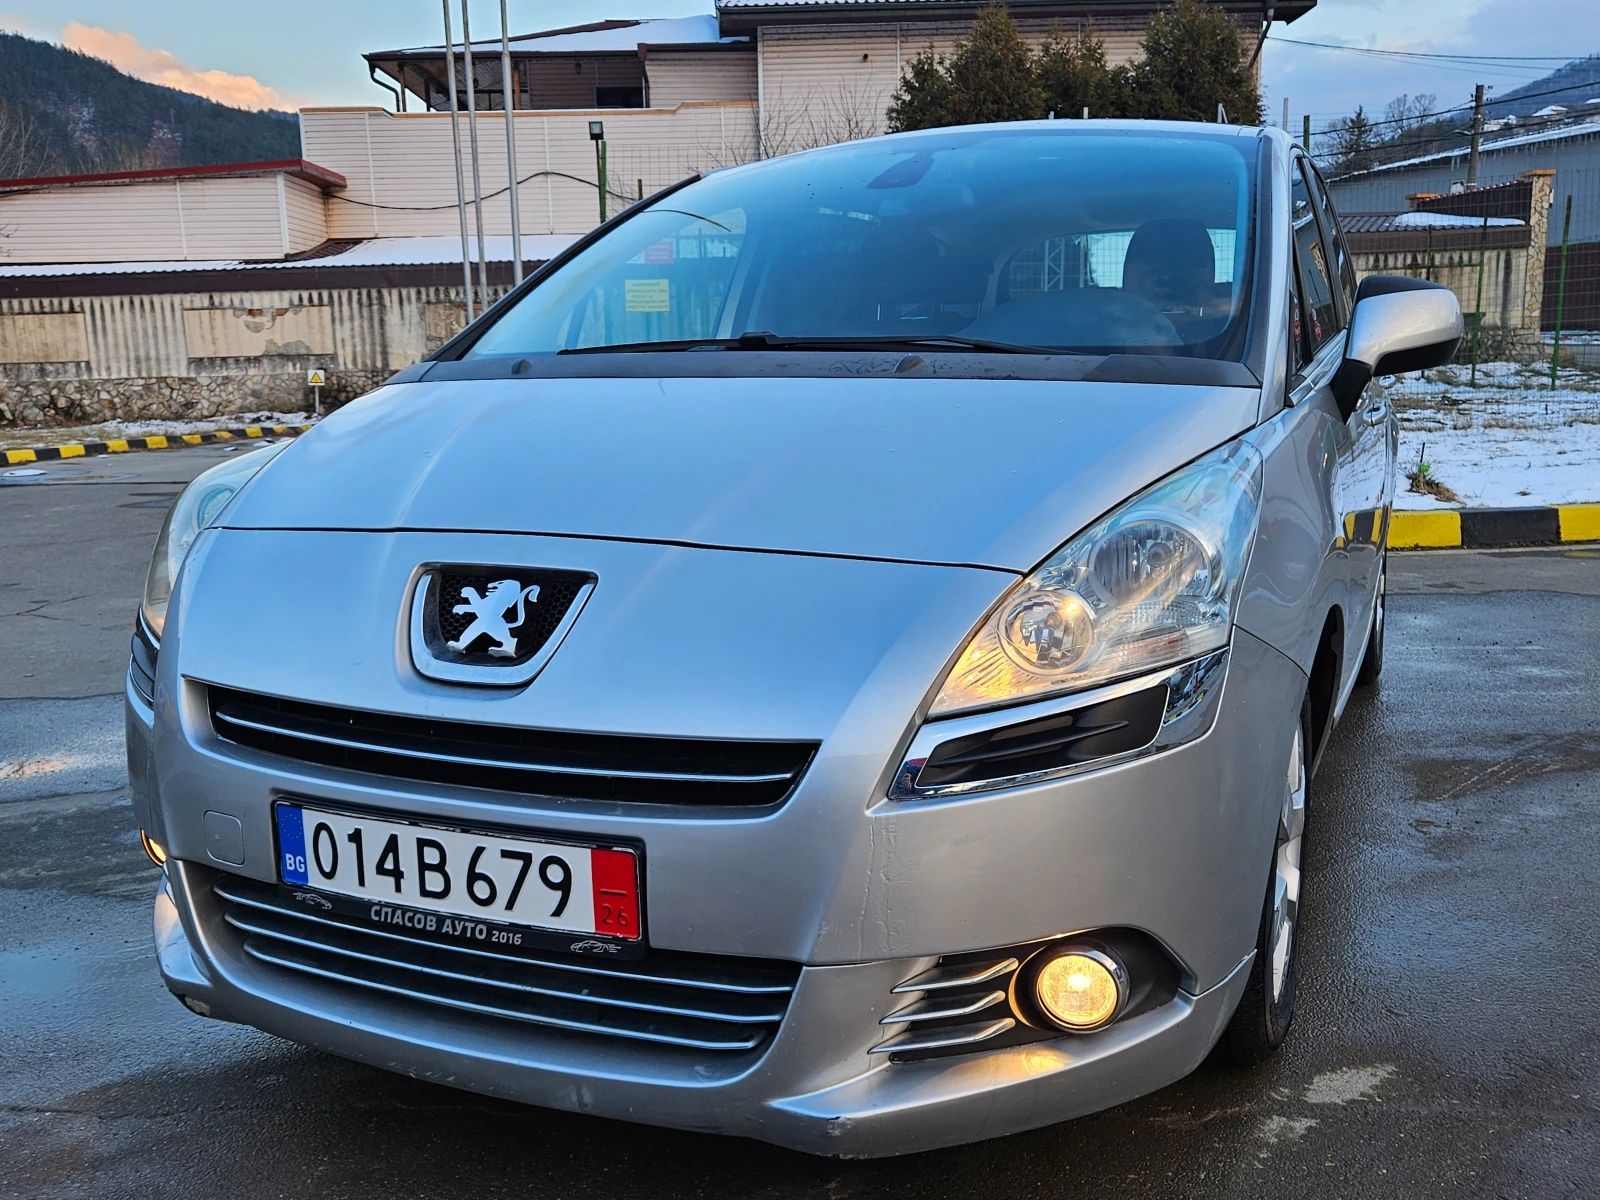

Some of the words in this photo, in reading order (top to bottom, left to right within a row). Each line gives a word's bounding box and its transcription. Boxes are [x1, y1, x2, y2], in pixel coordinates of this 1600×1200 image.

[285, 853, 305, 872] BG
[370, 905, 437, 931] СПАСОВ
[441, 916, 487, 940] АУТО
[491, 930, 522, 945] 2016
[601, 903, 629, 926] 26
